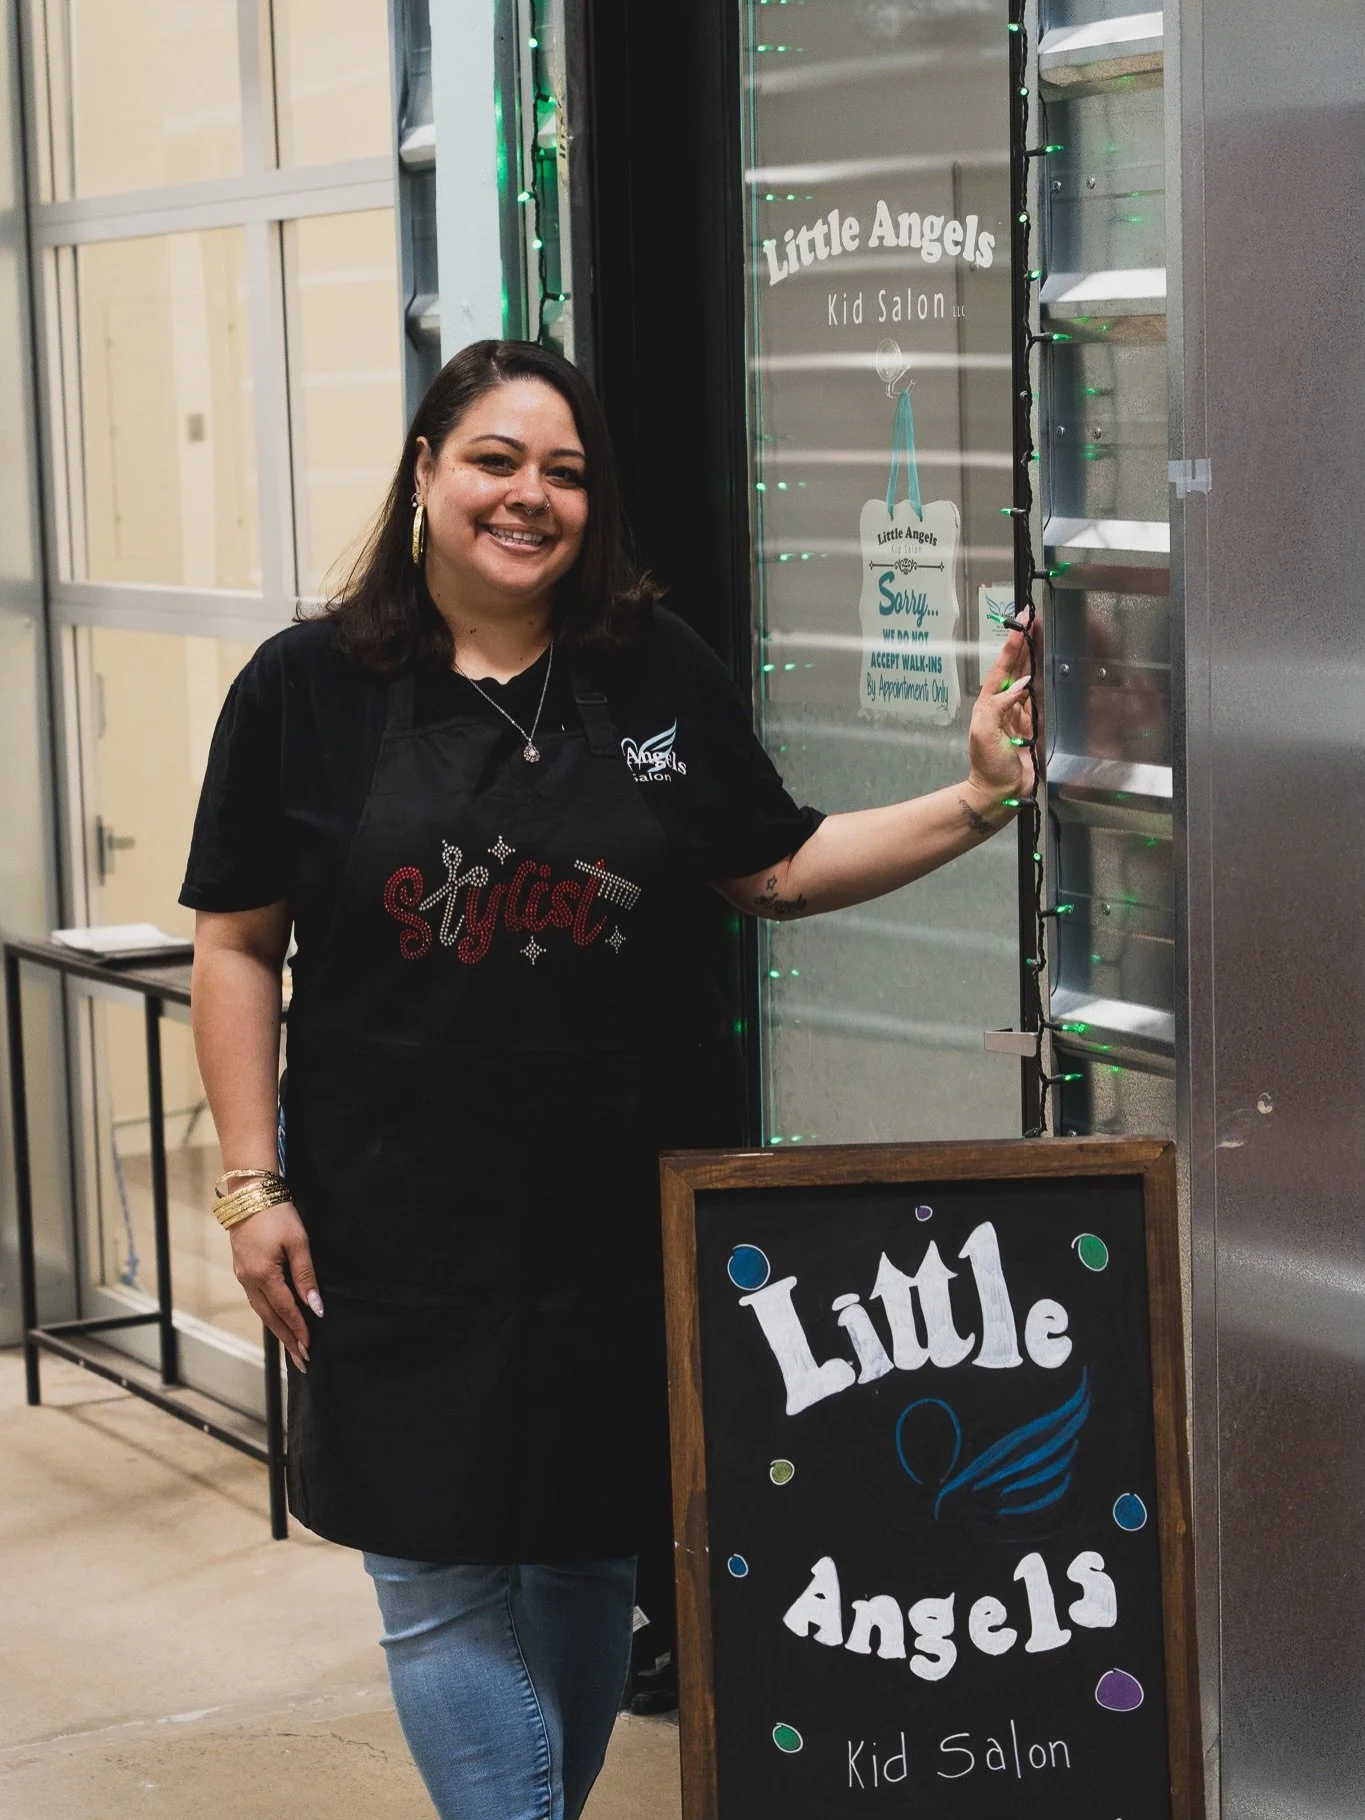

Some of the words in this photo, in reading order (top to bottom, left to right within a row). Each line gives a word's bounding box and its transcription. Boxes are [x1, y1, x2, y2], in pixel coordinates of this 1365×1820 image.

[763, 209, 860, 286] Little
[868, 200, 996, 268] Angels
[828, 292, 863, 326] Kid
[878, 288, 945, 323] Salon
[952, 304, 966, 318] LLC
[877, 527, 904, 546] Little
[905, 526, 938, 547] Angels
[878, 571, 939, 627] Sorry...
[882, 628, 896, 644] WE
[897, 629, 910, 645] DO
[911, 630, 929, 647] NOT
[870, 651, 900, 670] ACCEPT
[901, 653, 943, 674] WALK-INS
[866, 672, 877, 703] By
[931, 679, 950, 705] Only
[626, 746, 688, 776] Angels
[383, 839, 608, 965] Stylist
[738, 1220, 1074, 1417] Little
[782, 1550, 1118, 1682] Angels
[848, 1731, 908, 1789] Kid
[936, 1719, 1071, 1779] Salon
